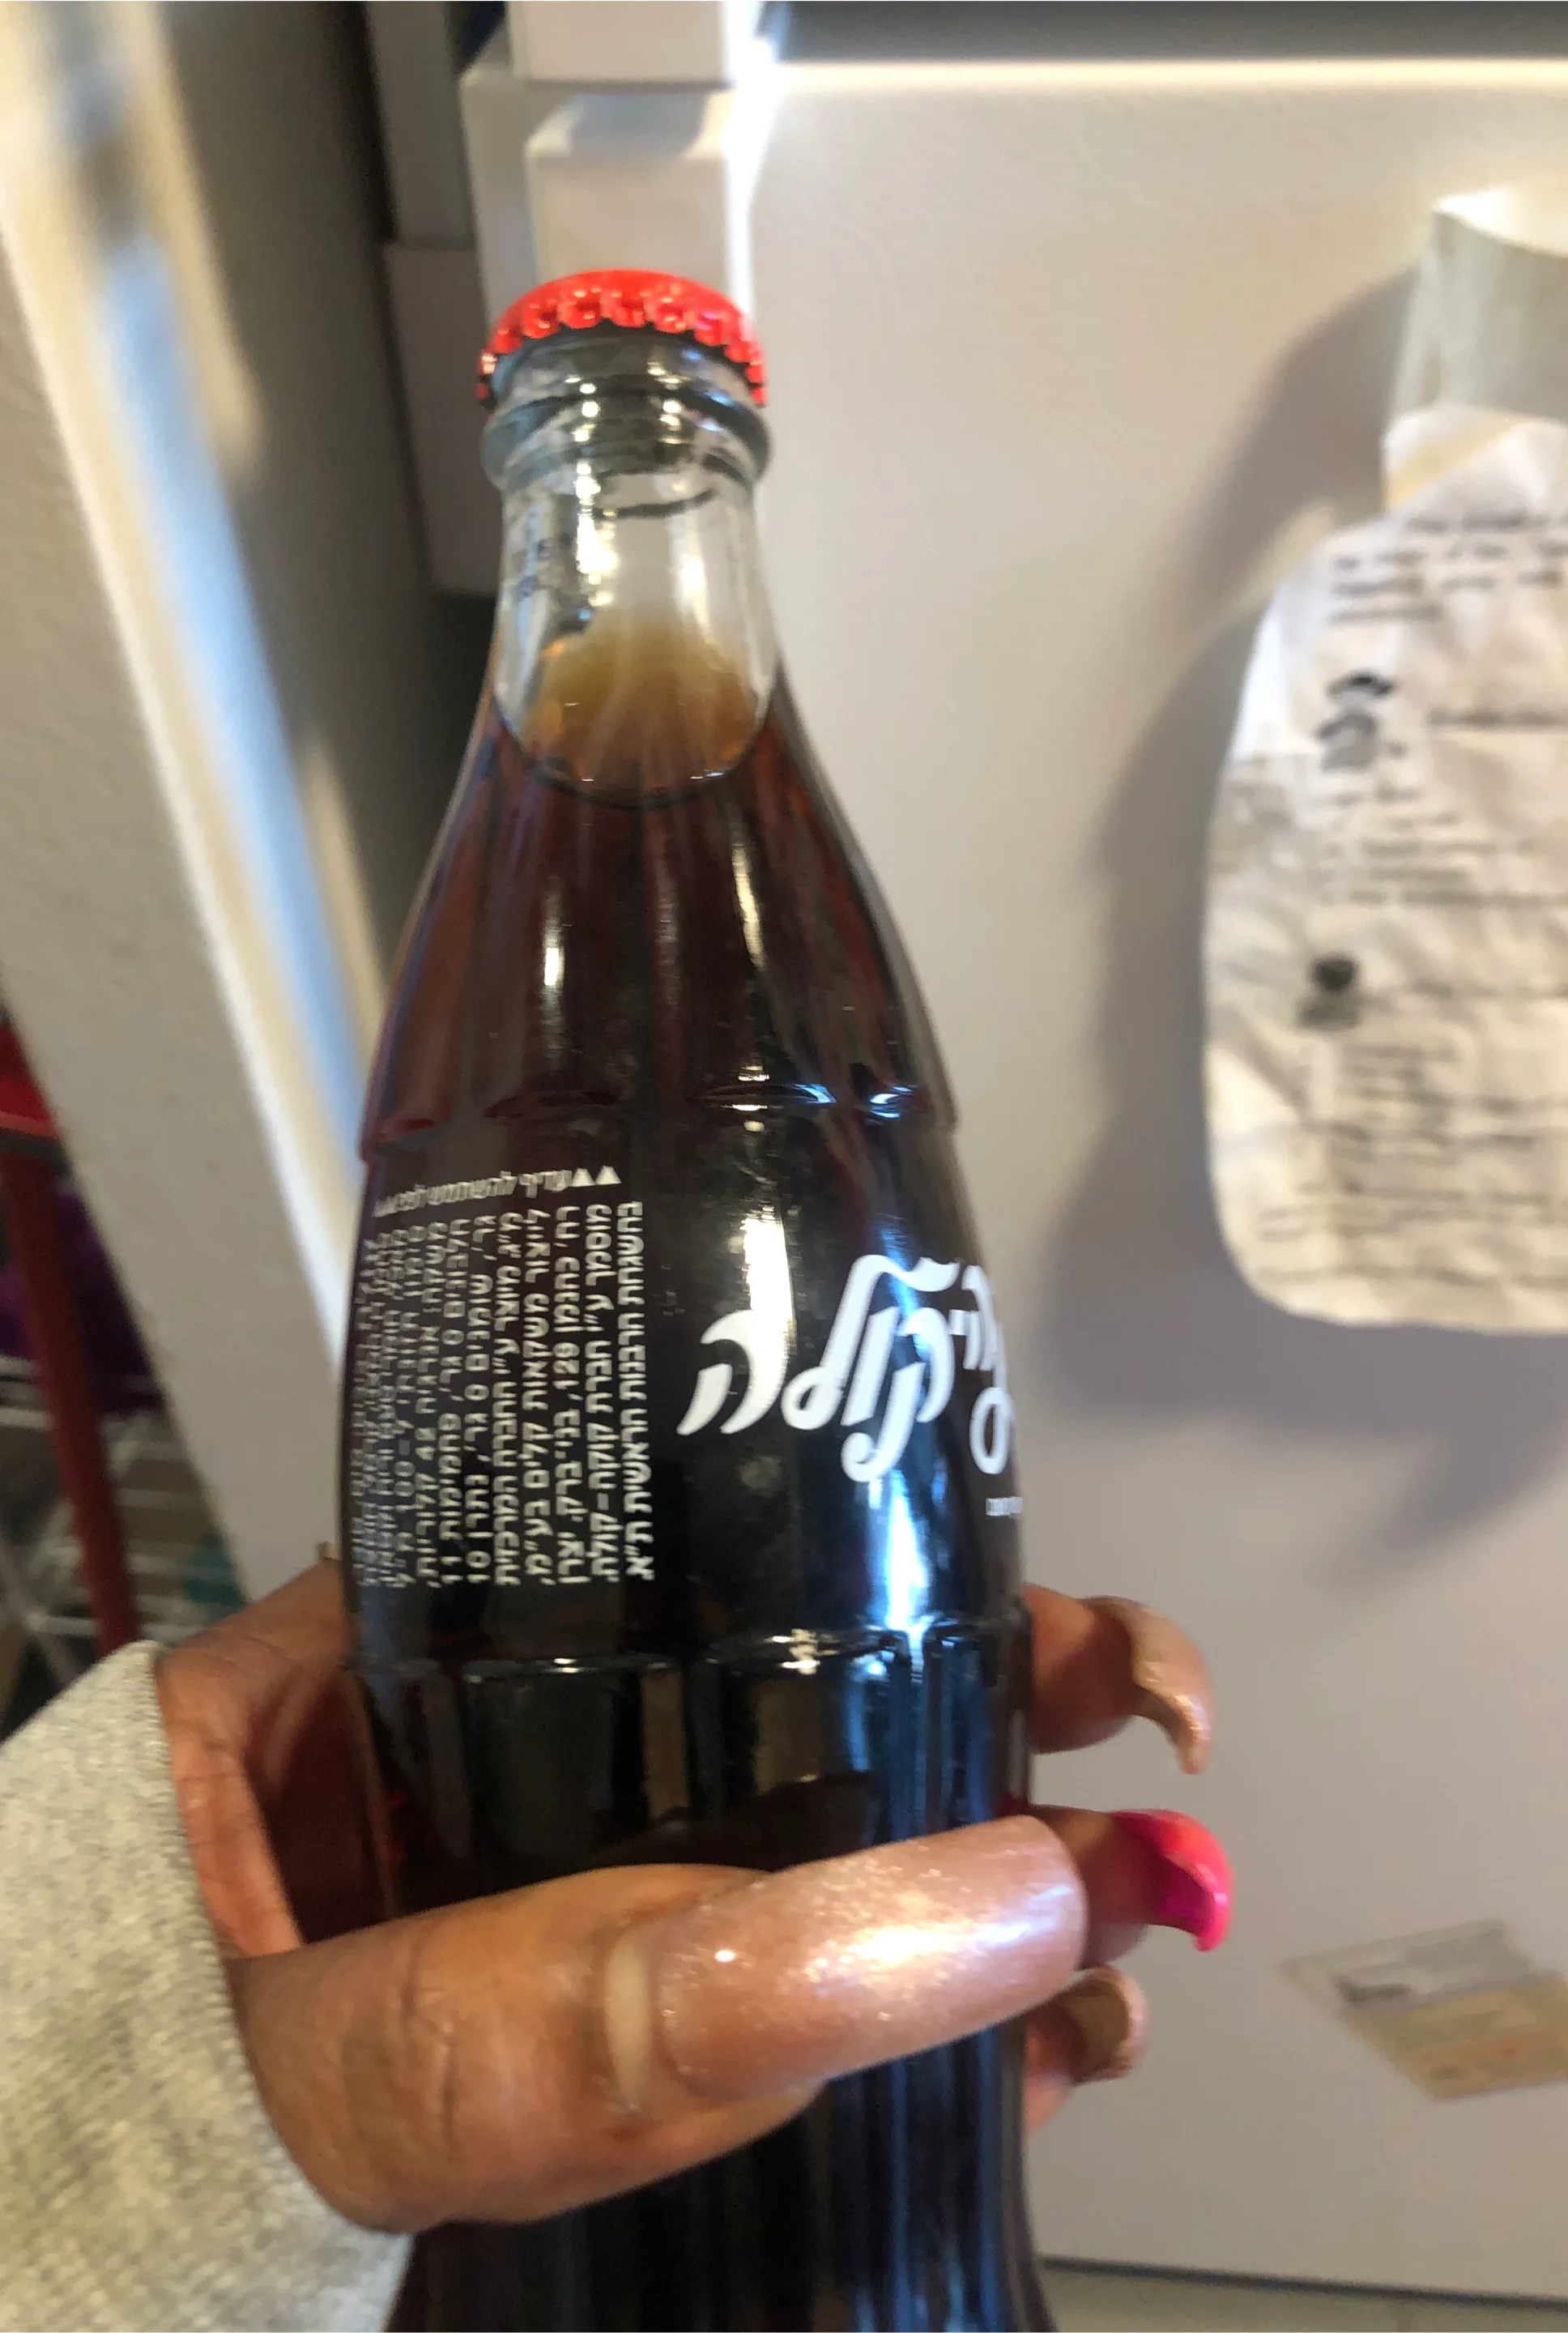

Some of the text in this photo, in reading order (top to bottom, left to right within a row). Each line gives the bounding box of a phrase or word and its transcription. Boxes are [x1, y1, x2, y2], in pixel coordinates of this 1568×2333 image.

[442, 1218, 471, 1318] חלבונים
[522, 1209, 552, 1283] לייצור
[585, 1204, 616, 1286] מוסמך
[466, 1273, 493, 1371] שומנים
[493, 1265, 521, 1331] מיוצר
[522, 1293, 552, 1410] משקאות
[585, 1340, 614, 1414] חברת
[437, 1413, 463, 1540] פחמימות
[518, 1422, 553, 1488] קלים
[464, 1474, 494, 1538] נתרן
[466, 1550, 492, 1584] 10
[556, 1532, 591, 1584] יצרן
